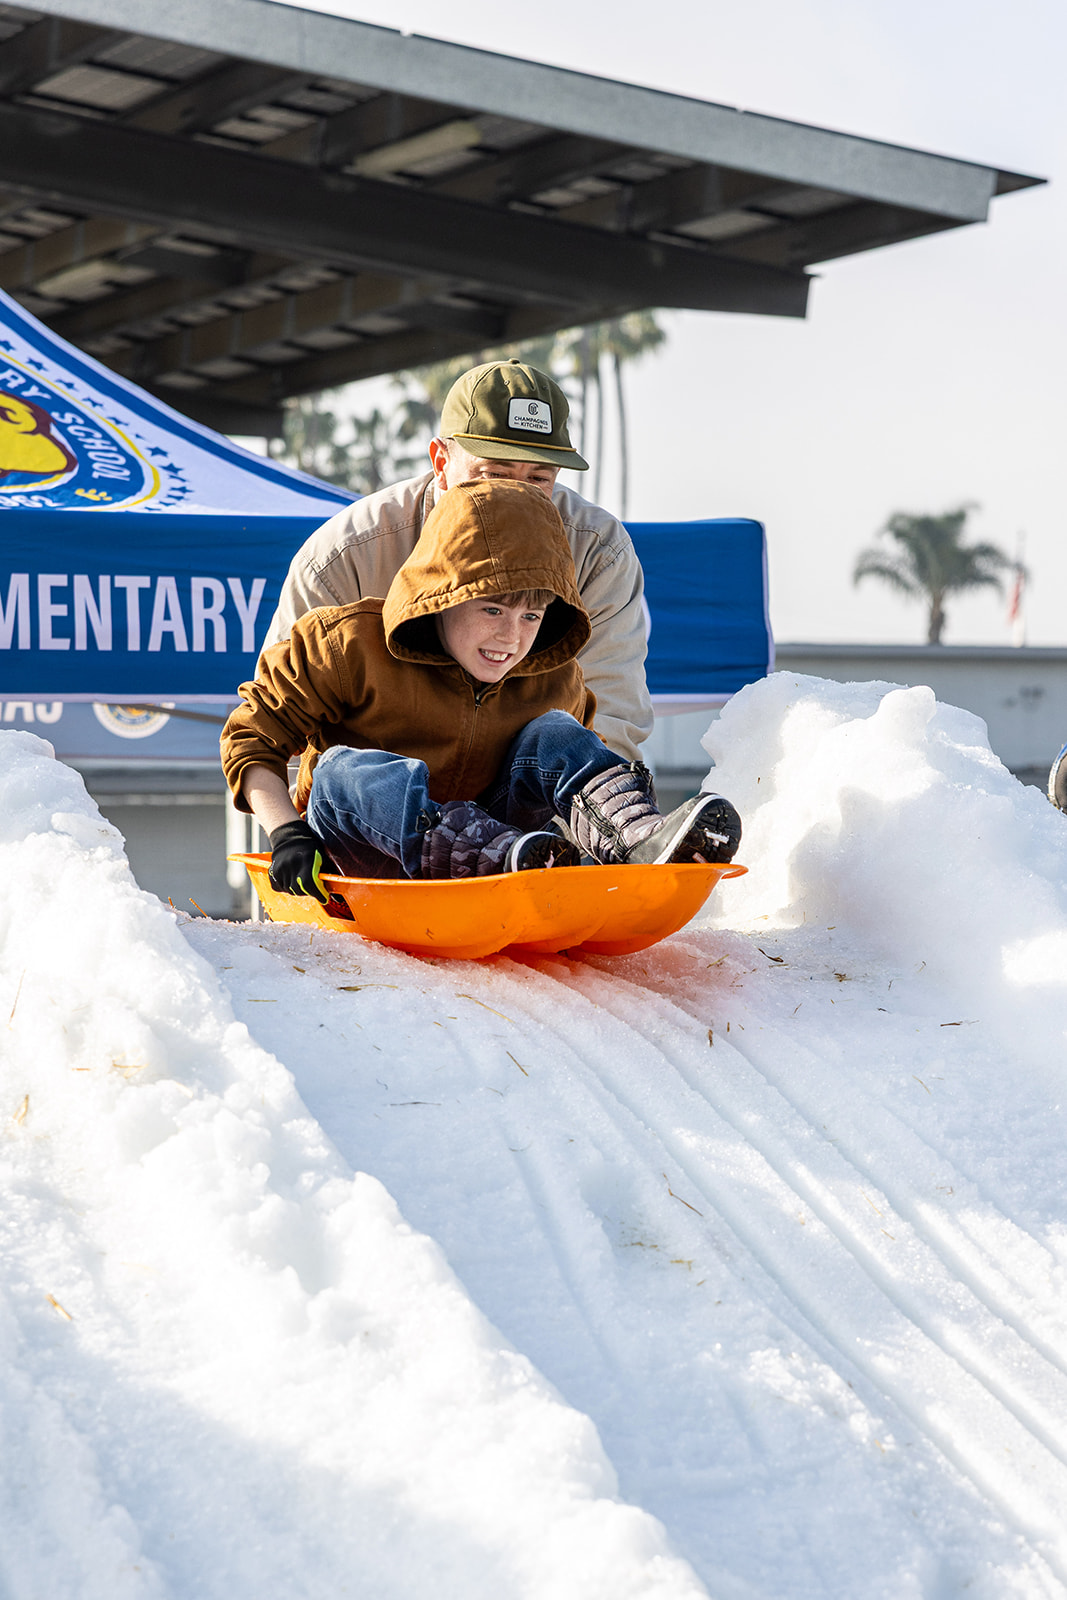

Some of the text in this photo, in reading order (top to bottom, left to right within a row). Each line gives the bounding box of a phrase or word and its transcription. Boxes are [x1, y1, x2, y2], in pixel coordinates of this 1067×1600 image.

[51, 411, 131, 481] SCHOOL
[521, 422, 544, 430] KITCHEN
[0, 573, 267, 653] MENTARY
